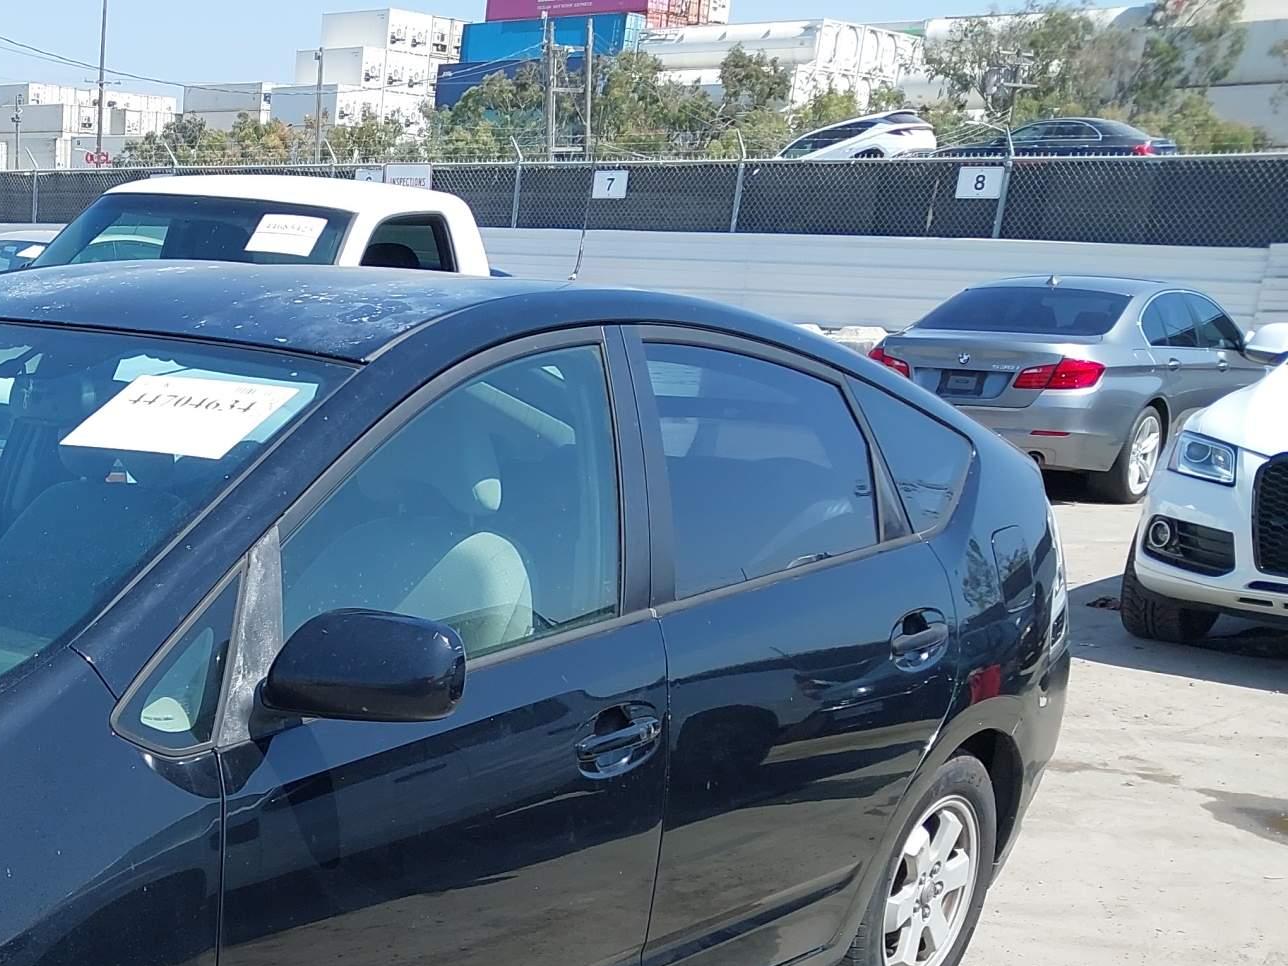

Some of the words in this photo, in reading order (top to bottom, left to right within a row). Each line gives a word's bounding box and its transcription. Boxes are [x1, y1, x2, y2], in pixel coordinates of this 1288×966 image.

[389, 177, 426, 187] INSPECTIONS
[606, 177, 615, 192] 7
[974, 174, 986, 191] 8
